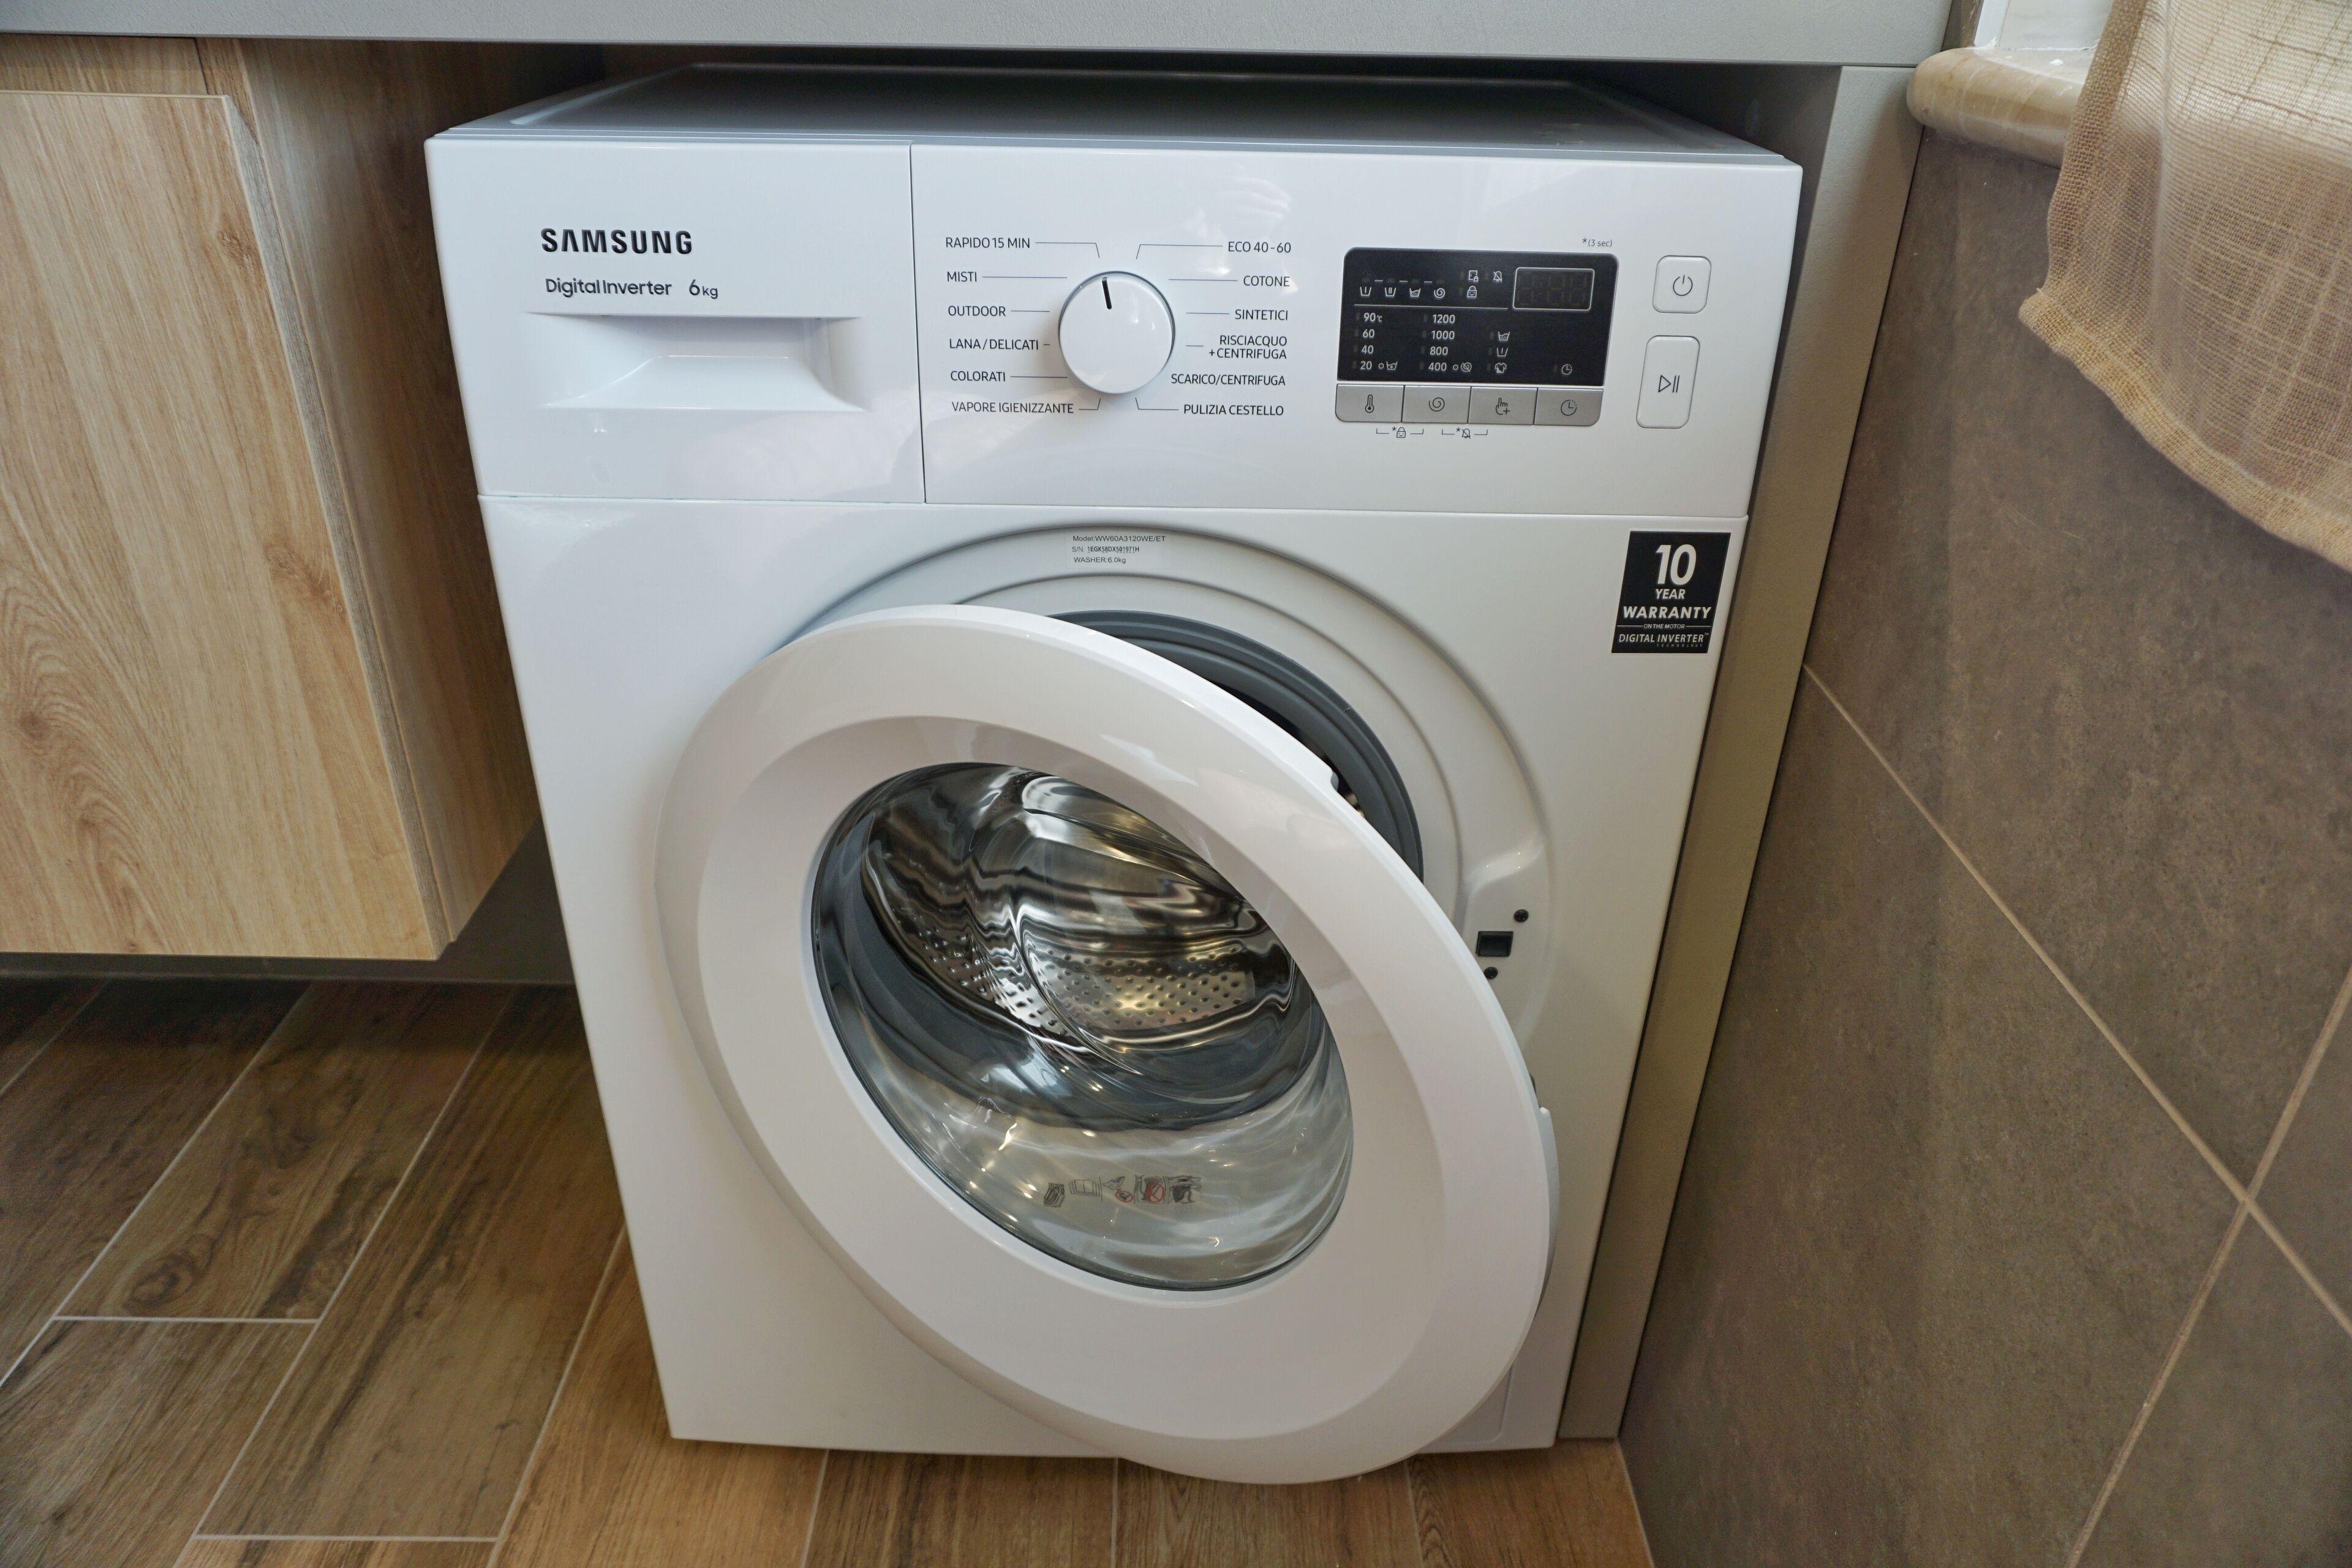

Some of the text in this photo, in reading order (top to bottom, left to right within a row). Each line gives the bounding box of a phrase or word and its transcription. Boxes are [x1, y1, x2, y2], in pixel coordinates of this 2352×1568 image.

[541, 228, 692, 254] SAMSUNG
[946, 238, 1030, 248] RAPIDO 15 MIN
[1229, 241, 1251, 252] ECO
[948, 271, 976, 282] MISTI
[1243, 276, 1289, 286] COTONE
[948, 306, 1005, 316] OUTDOOR
[1235, 309, 1287, 320] SINTETICI
[1433, 314, 1455, 323] 1200
[1363, 329, 1374, 337] 60
[1431, 331, 1455, 339] 1000
[1220, 335, 1287, 347] RISCIACQUO
[1362, 345, 1373, 354] 40
[1430, 347, 1448, 355] 800
[1360, 361, 1372, 369] 20
[1428, 363, 1447, 371] 400
[951, 371, 1005, 382] COLORATI
[1172, 374, 1285, 385] SCARICO/CENTRIFUGA
[952, 402, 1074, 413] VAPORE IGIENIZZANTE
[1185, 404, 1283, 415] PULIZIA CESTELLO
[1656, 544, 1697, 586] 10
[1656, 588, 1686, 600] YEAR
[1623, 606, 1711, 619] WARRANTY
[1618, 633, 1655, 643] DIGITAL
